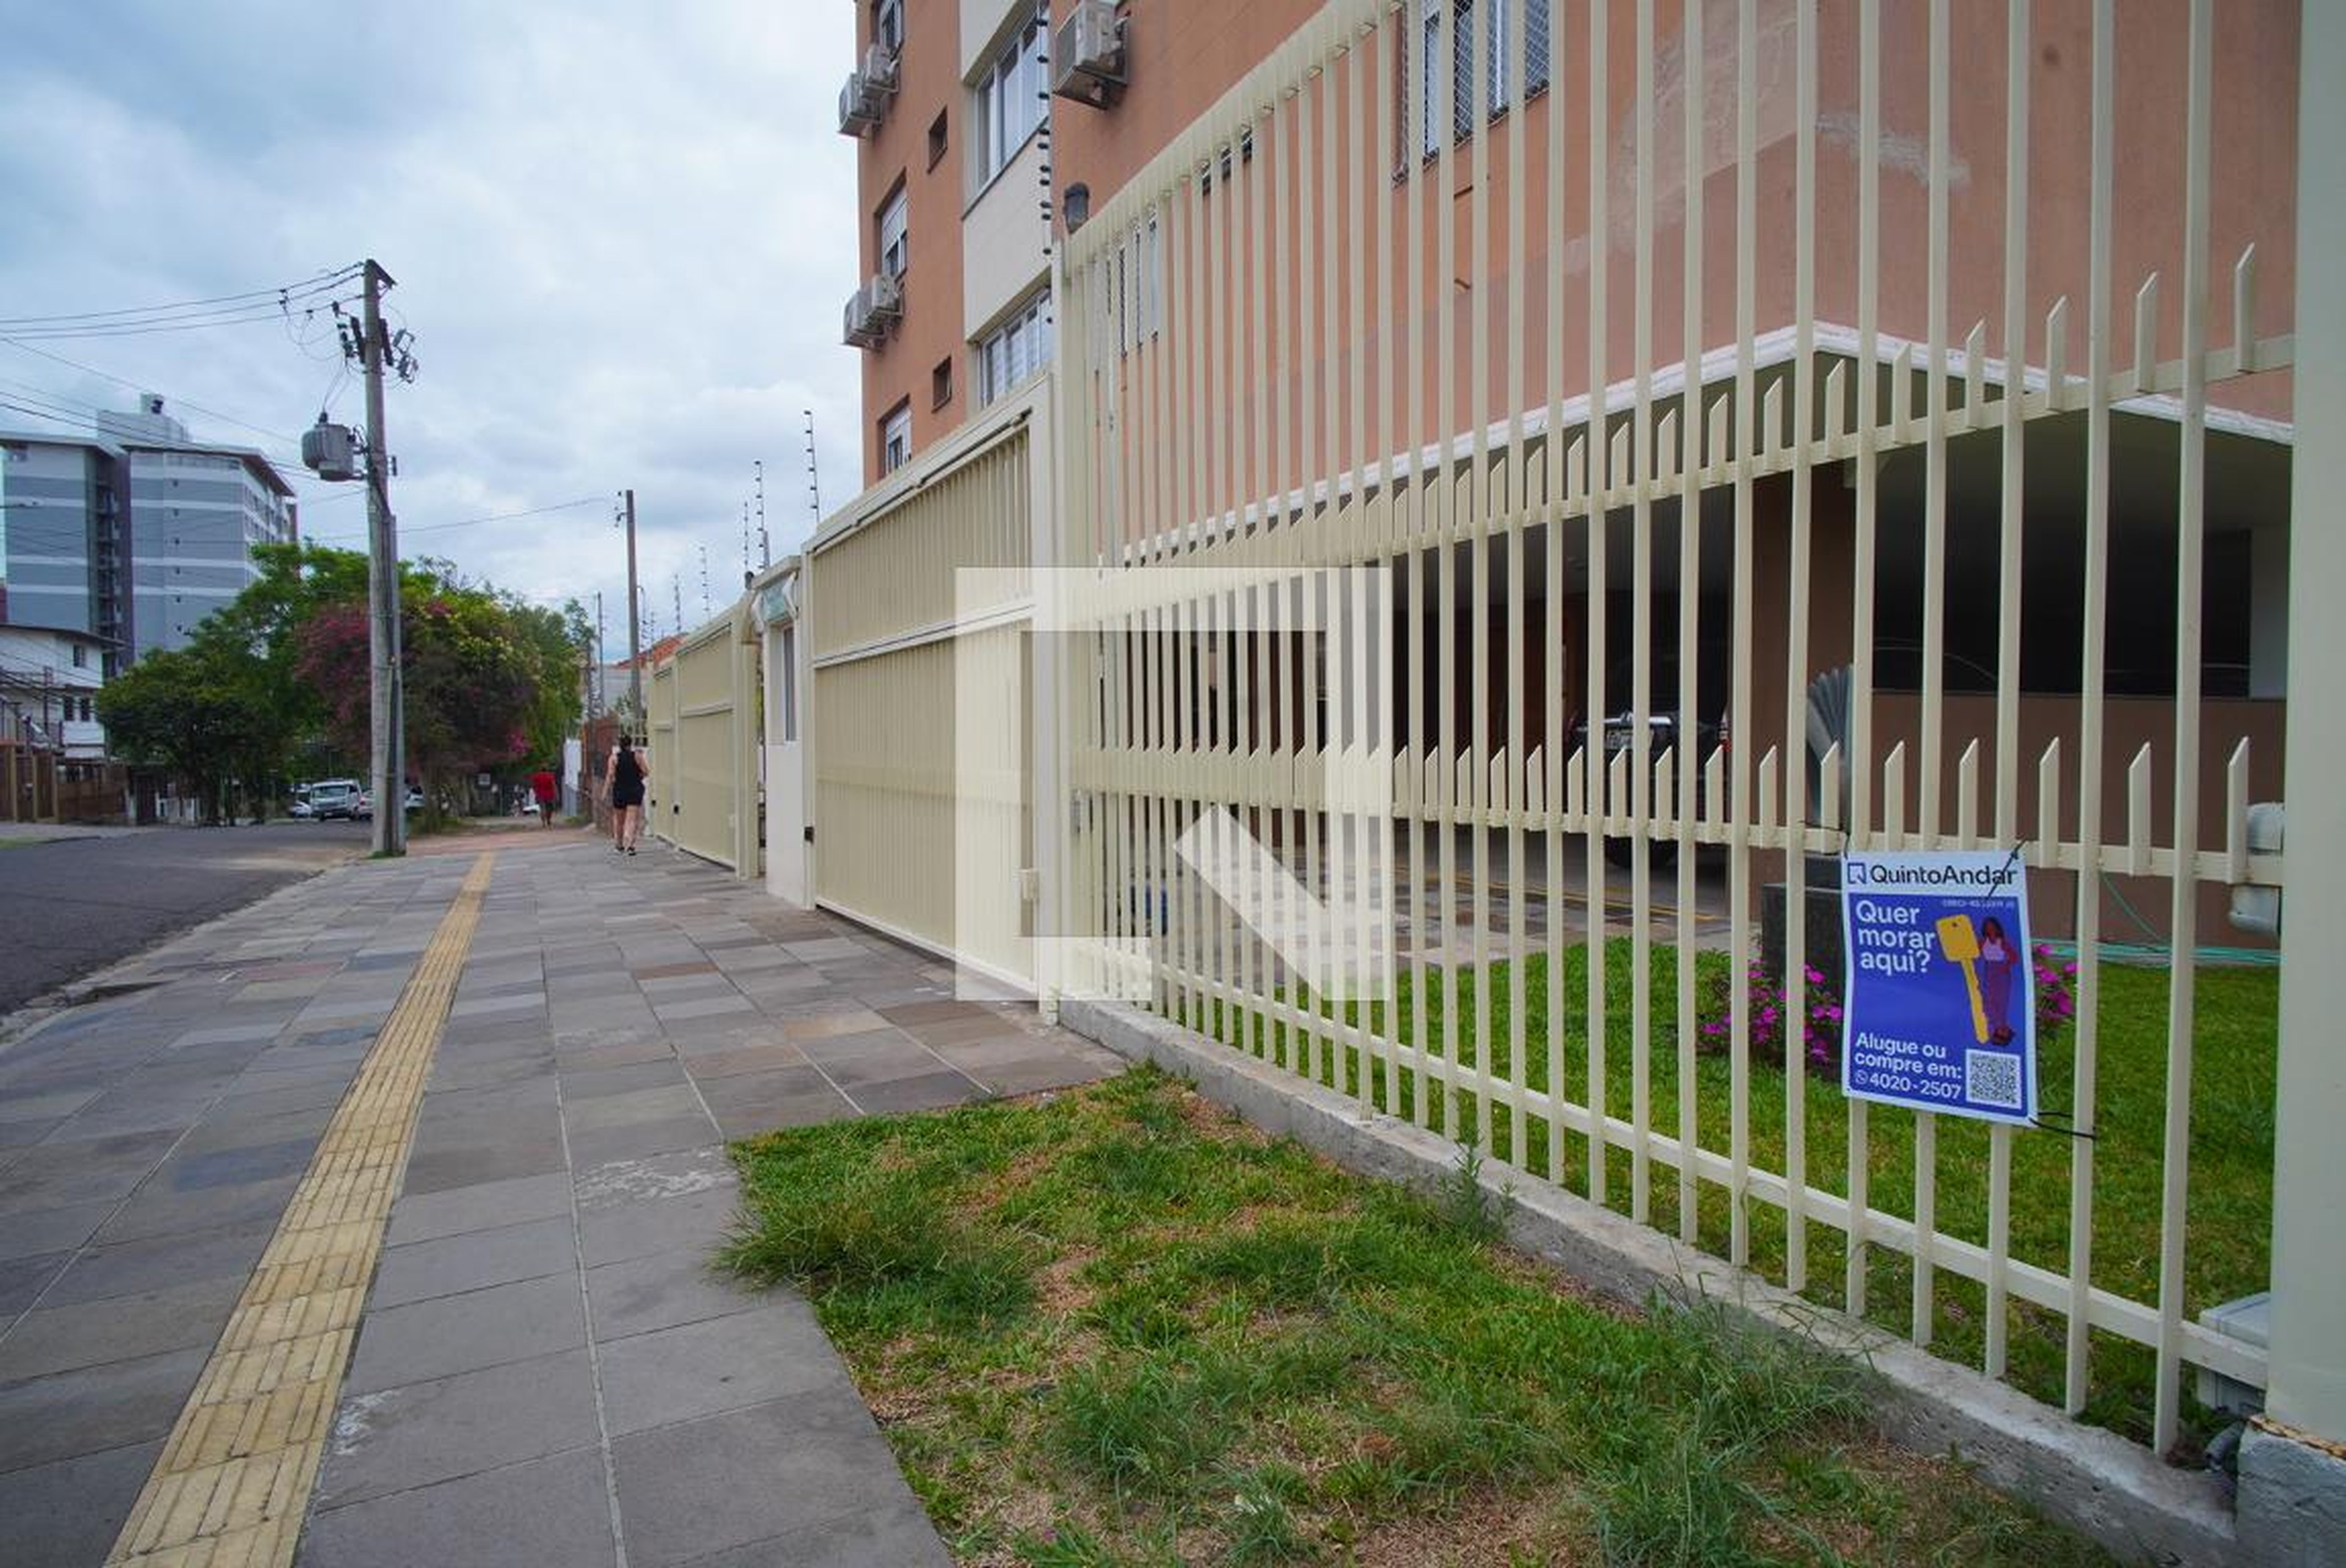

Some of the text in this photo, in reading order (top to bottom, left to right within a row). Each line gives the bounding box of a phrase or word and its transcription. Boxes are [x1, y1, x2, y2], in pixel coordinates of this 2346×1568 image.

[1870, 864, 2017, 885] QuintoAndar
[1856, 900, 1920, 925] Quer
[1858, 928, 1935, 949] morar
[1861, 949, 1931, 976] aqui?
[1855, 1032, 1946, 1059] Alugue ou
[1855, 1052, 1962, 1079] compre em:
